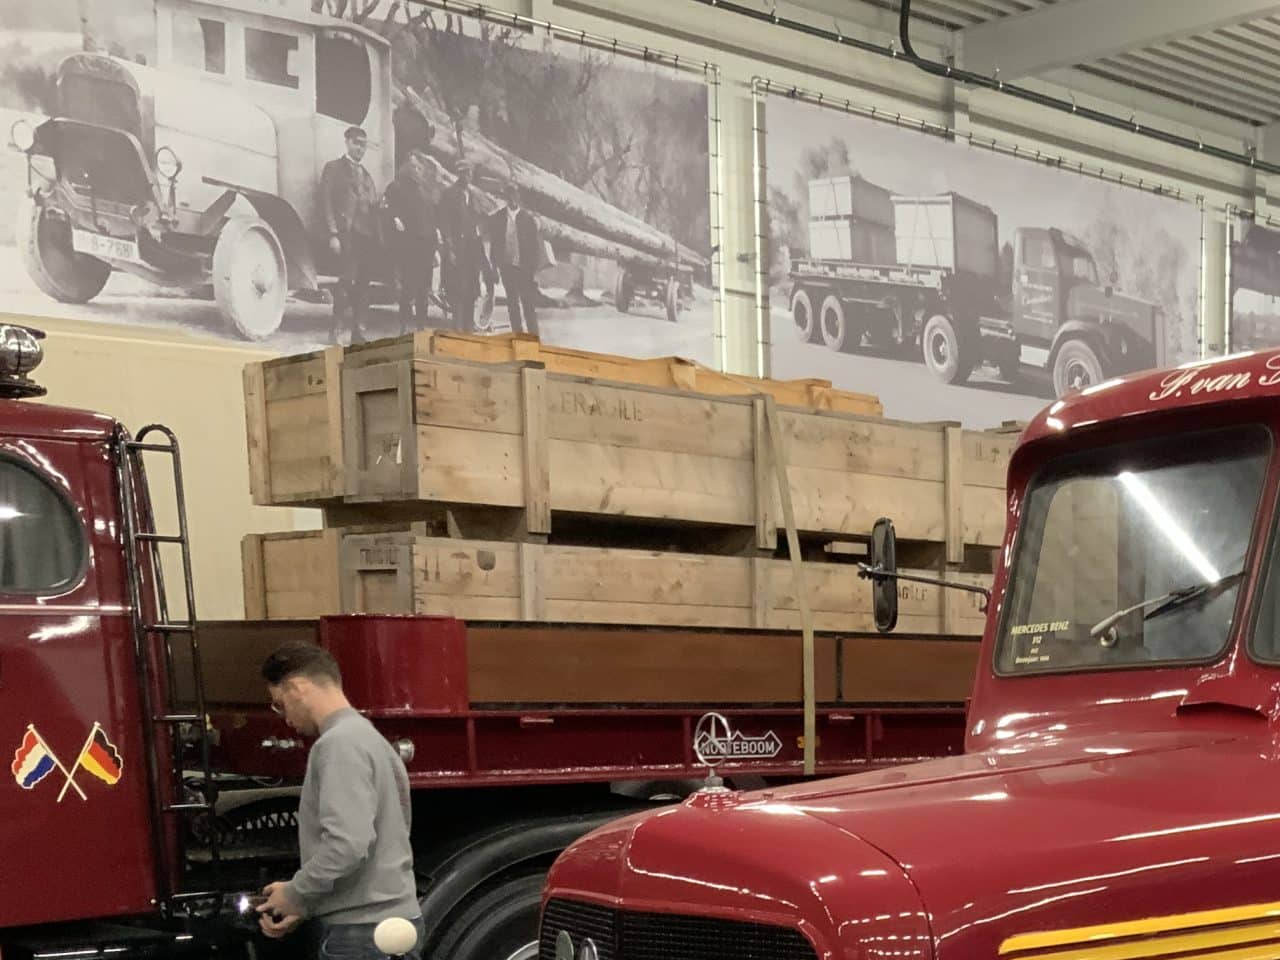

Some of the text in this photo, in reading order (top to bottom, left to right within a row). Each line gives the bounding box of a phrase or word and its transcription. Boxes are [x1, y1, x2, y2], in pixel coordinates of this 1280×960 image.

[1191, 371, 1251, 395] van
[560, 391, 642, 421] FRAILE
[1011, 621, 1069, 635] MERCEDES BENZ
